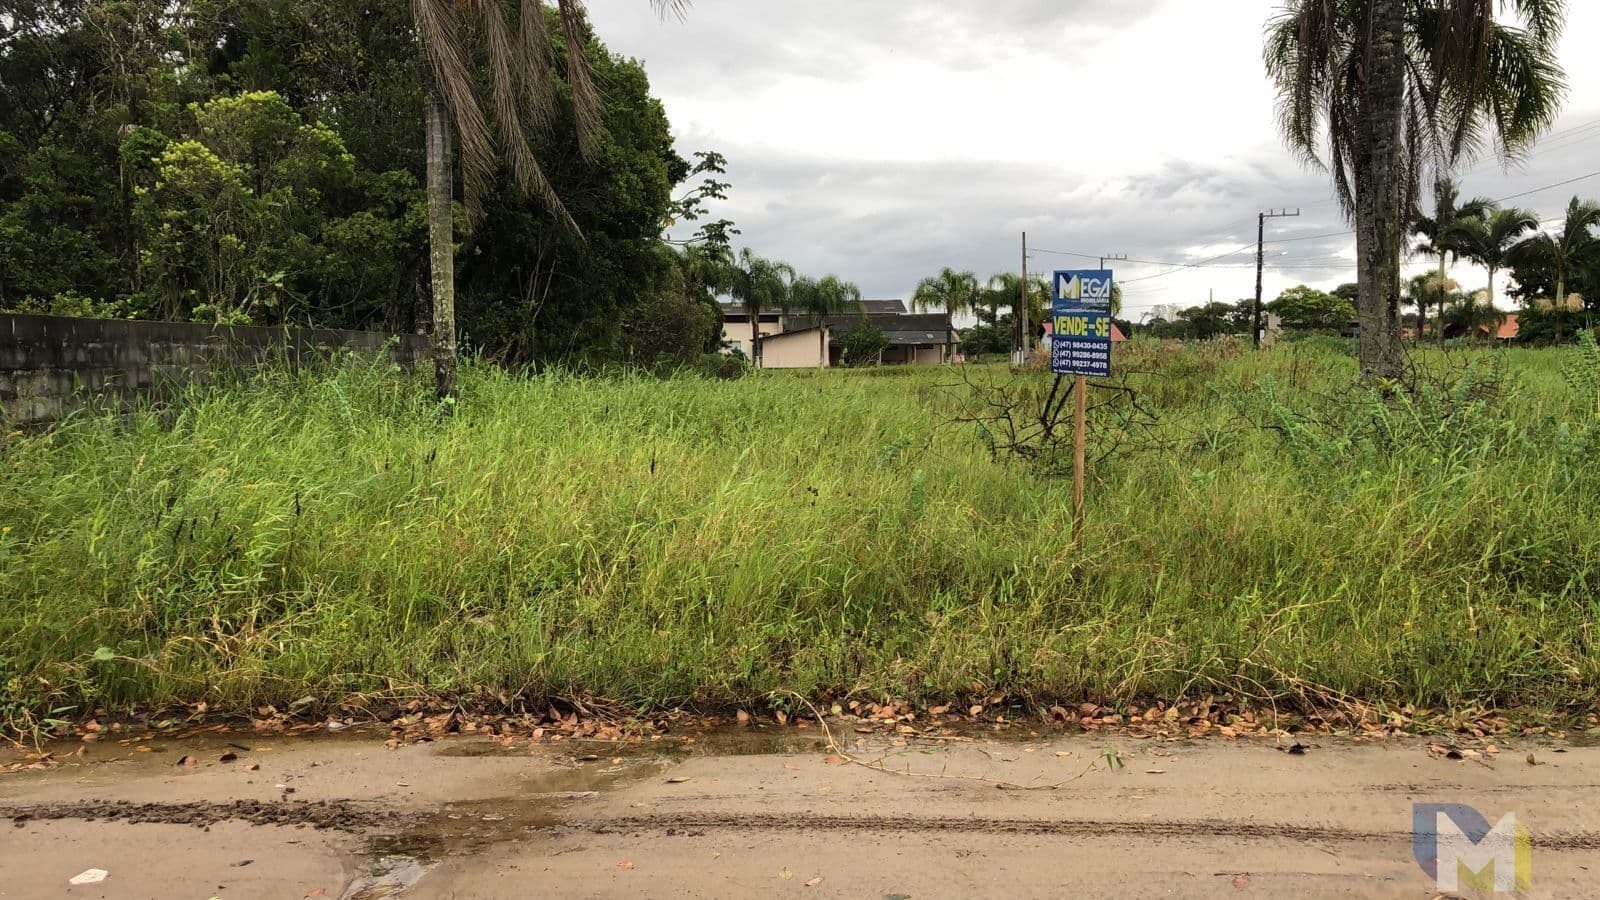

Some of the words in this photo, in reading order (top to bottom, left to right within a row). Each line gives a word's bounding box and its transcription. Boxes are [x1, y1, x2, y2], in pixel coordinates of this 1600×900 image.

[1059, 274, 1110, 299] MEGA
[1053, 316, 1110, 337] VENDE-SE
[1060, 340, 1071, 349] (47)
[1060, 350, 1071, 358] (47)
[1060, 359, 1071, 368] (47)
